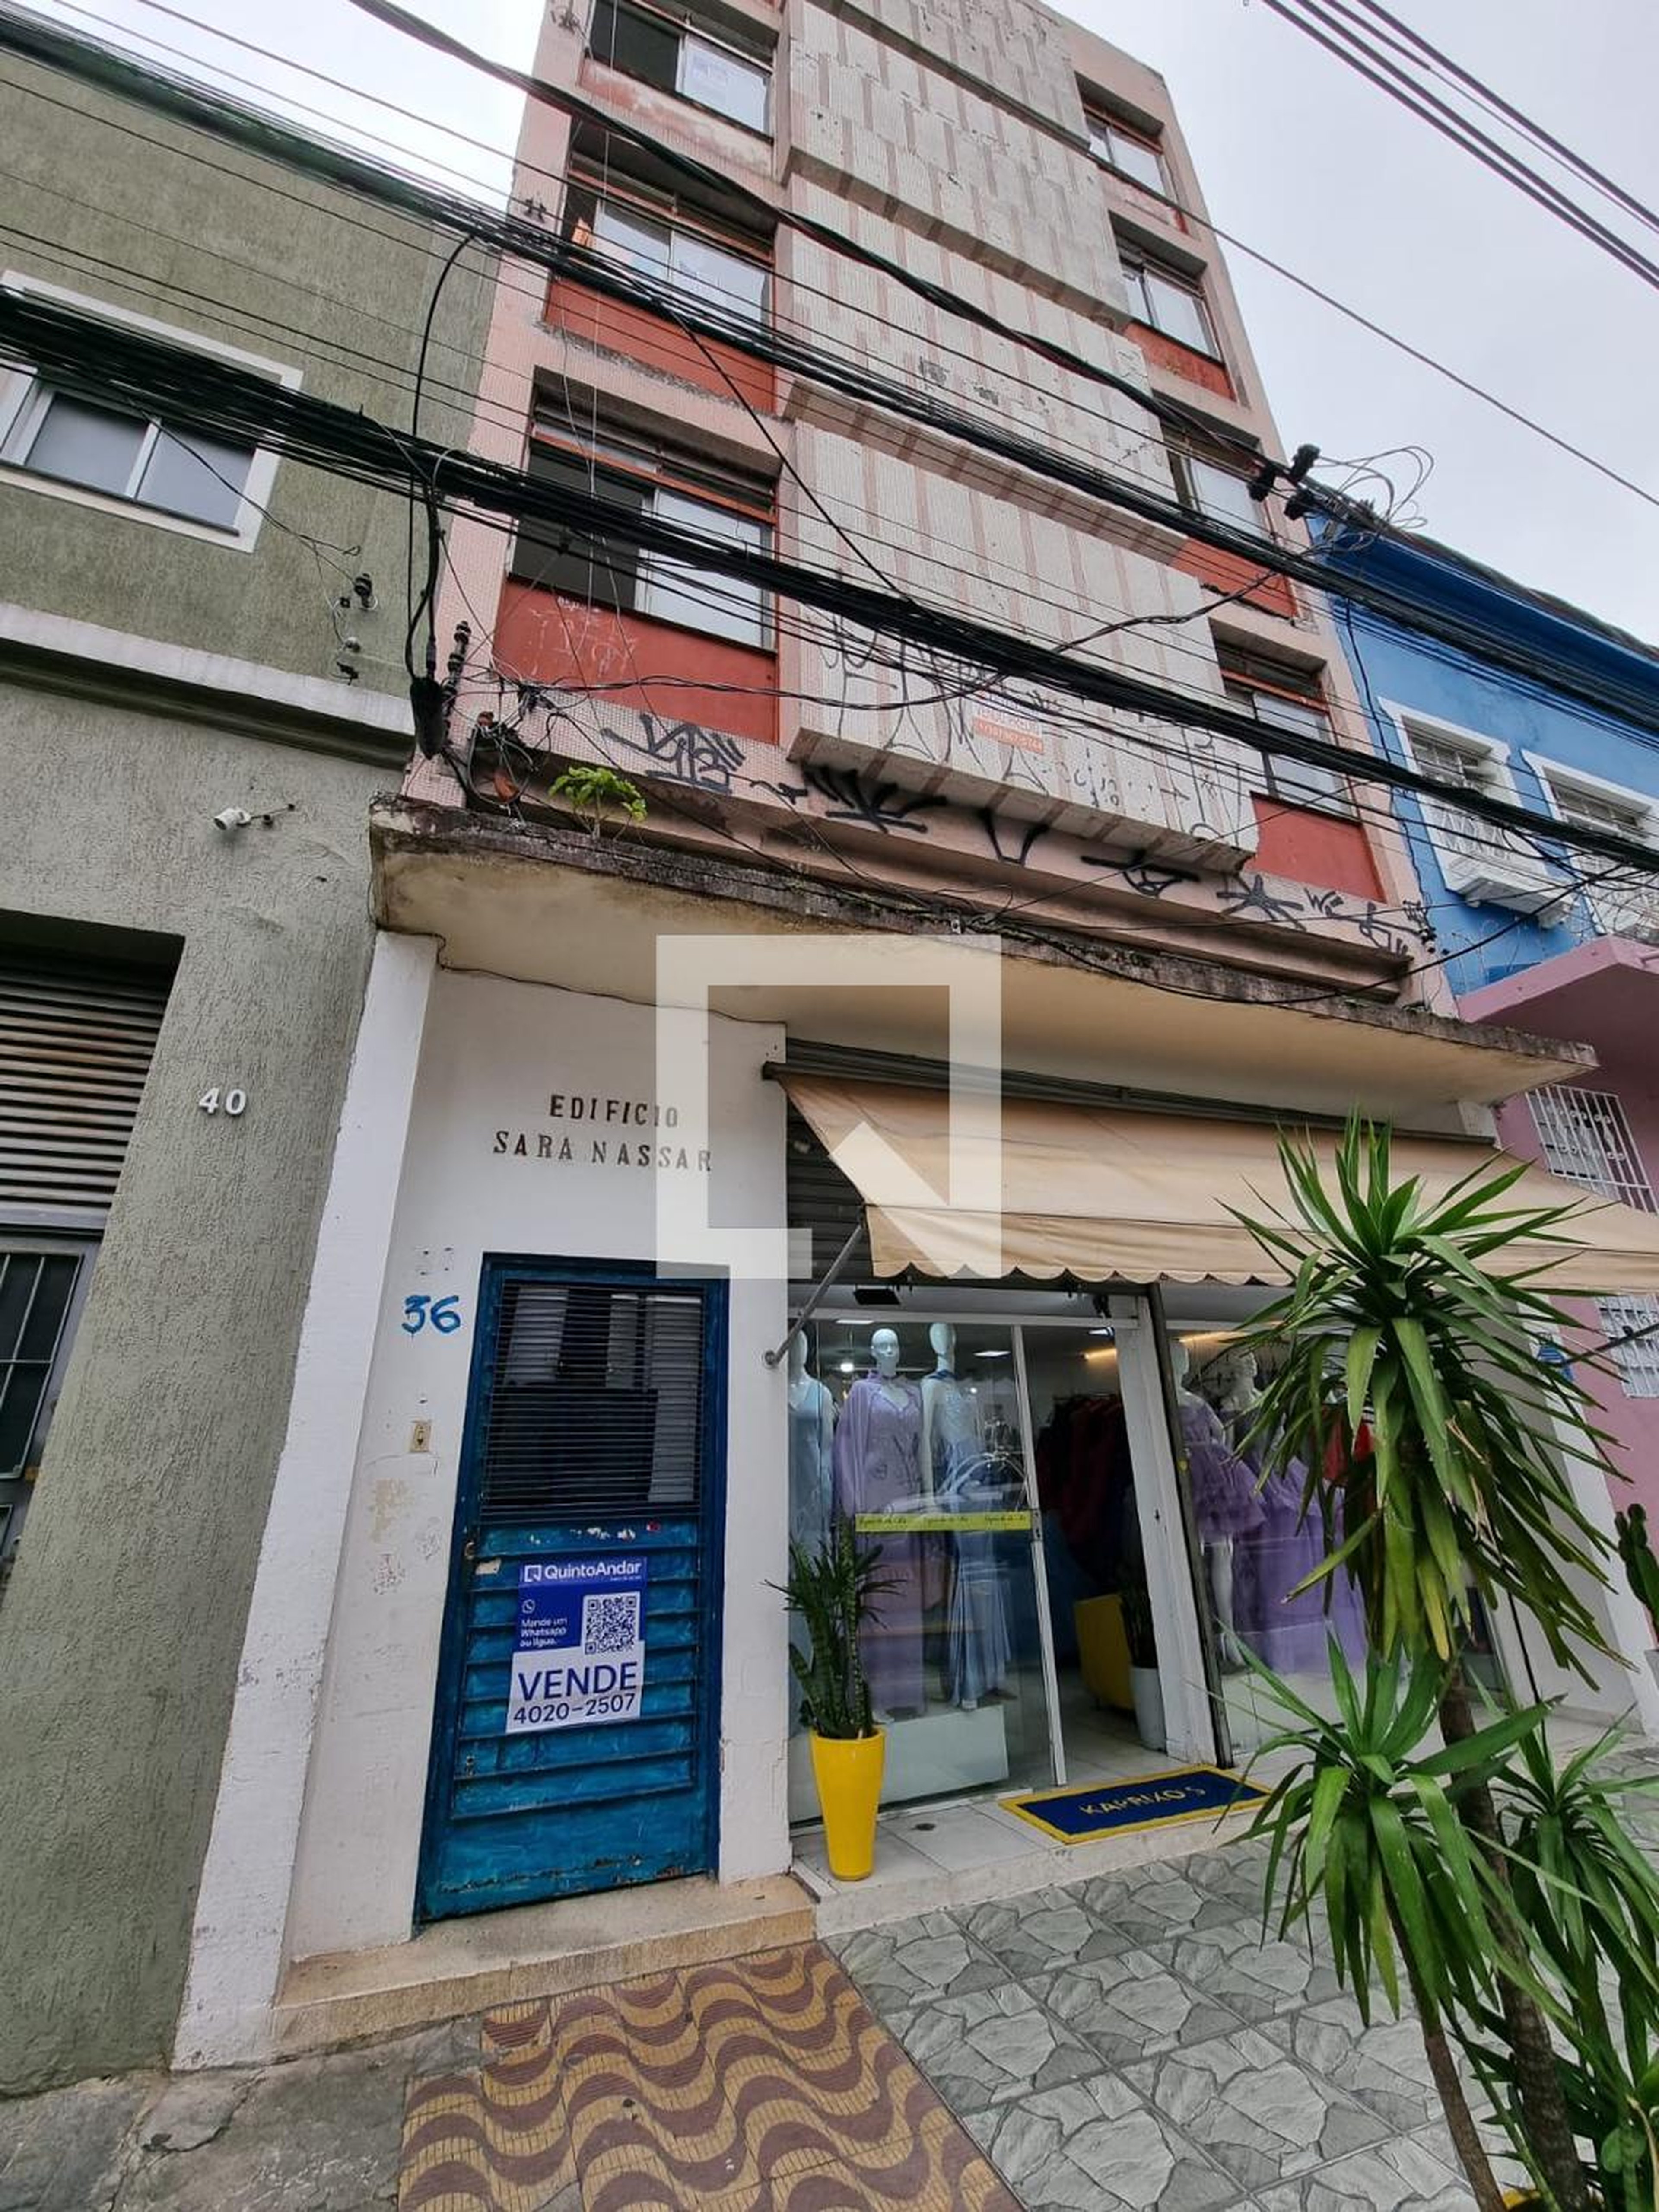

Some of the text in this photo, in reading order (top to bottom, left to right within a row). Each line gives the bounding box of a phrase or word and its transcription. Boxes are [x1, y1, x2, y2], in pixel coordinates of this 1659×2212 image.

[199, 1087, 247, 1115] 40
[550, 1094, 678, 1128] EDIFICIO
[493, 1130, 712, 1172] SARA NASSAR
[401, 1295, 461, 1334] 36
[544, 1560, 642, 1579] QuintoAndar
[518, 1661, 638, 1702] VENDE
[513, 1693, 636, 1724] 4020-2507
